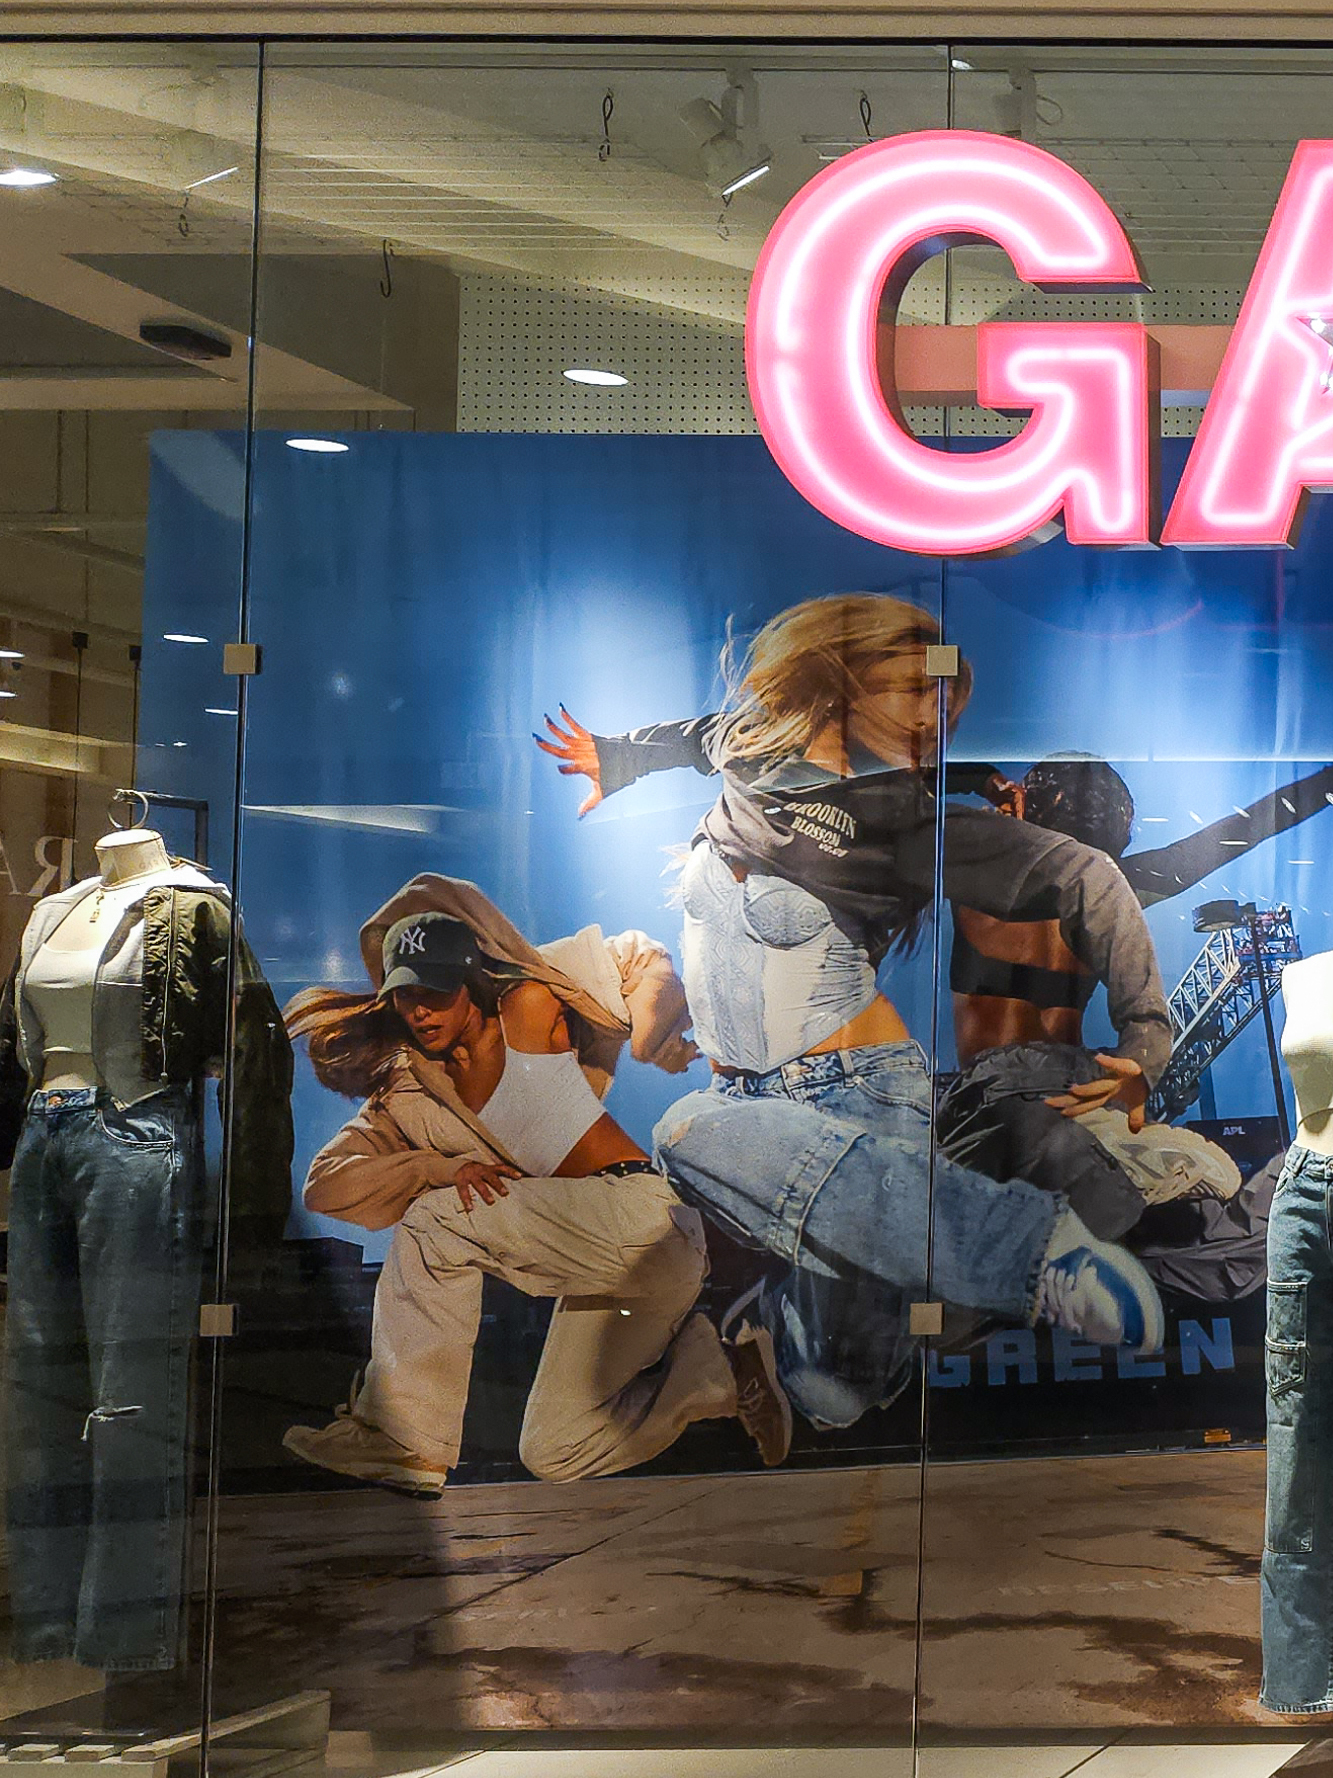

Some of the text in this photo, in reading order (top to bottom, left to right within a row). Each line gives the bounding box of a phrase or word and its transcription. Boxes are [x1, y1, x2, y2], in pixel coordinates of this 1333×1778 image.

[790, 815, 841, 848] BLOSSOM
[399, 925, 426, 955] NY
[1222, 1125, 1246, 1136] APL
[920, 1317, 1236, 1388] GREEN
